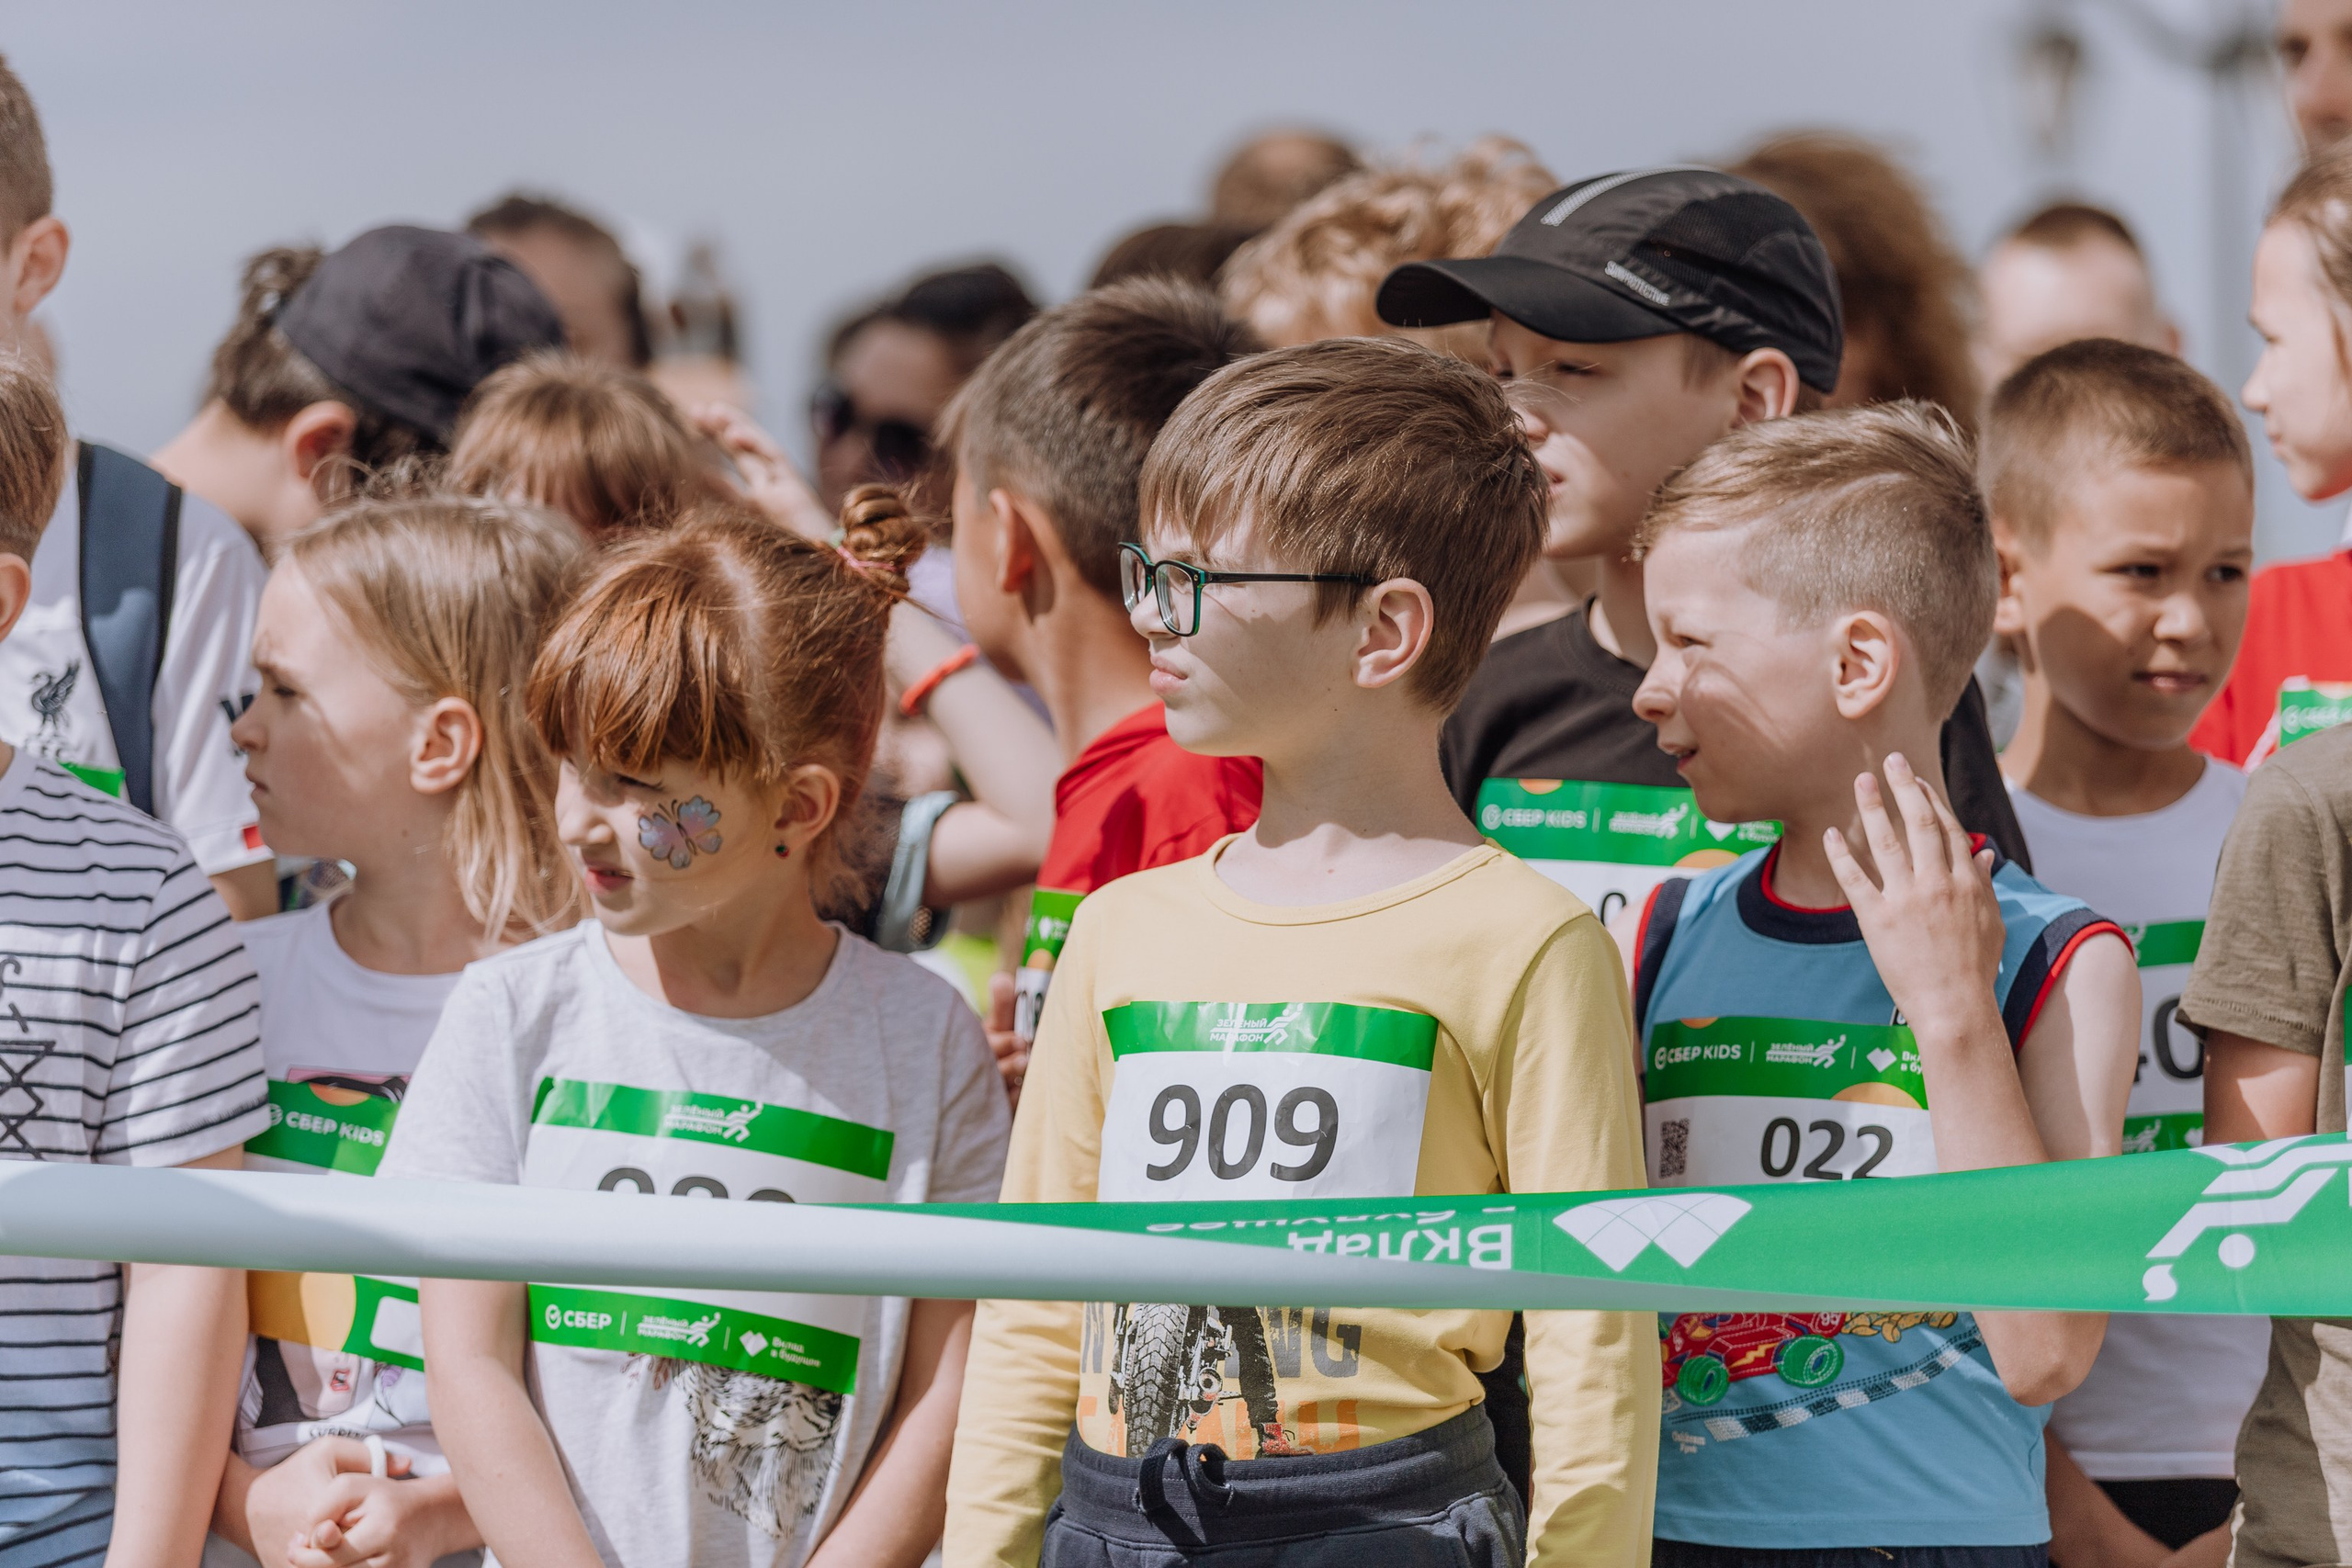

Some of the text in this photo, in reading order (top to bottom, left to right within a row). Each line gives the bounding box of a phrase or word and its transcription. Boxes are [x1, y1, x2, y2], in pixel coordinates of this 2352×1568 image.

[1668, 1043, 1741, 1064] СБЕР KIDS
[286, 1111, 386, 1147] СБЕР KIDS
[1147, 1084, 1339, 1181] 909
[1760, 1117, 1894, 1180] 022
[563, 1310, 612, 1330] СБЕР
